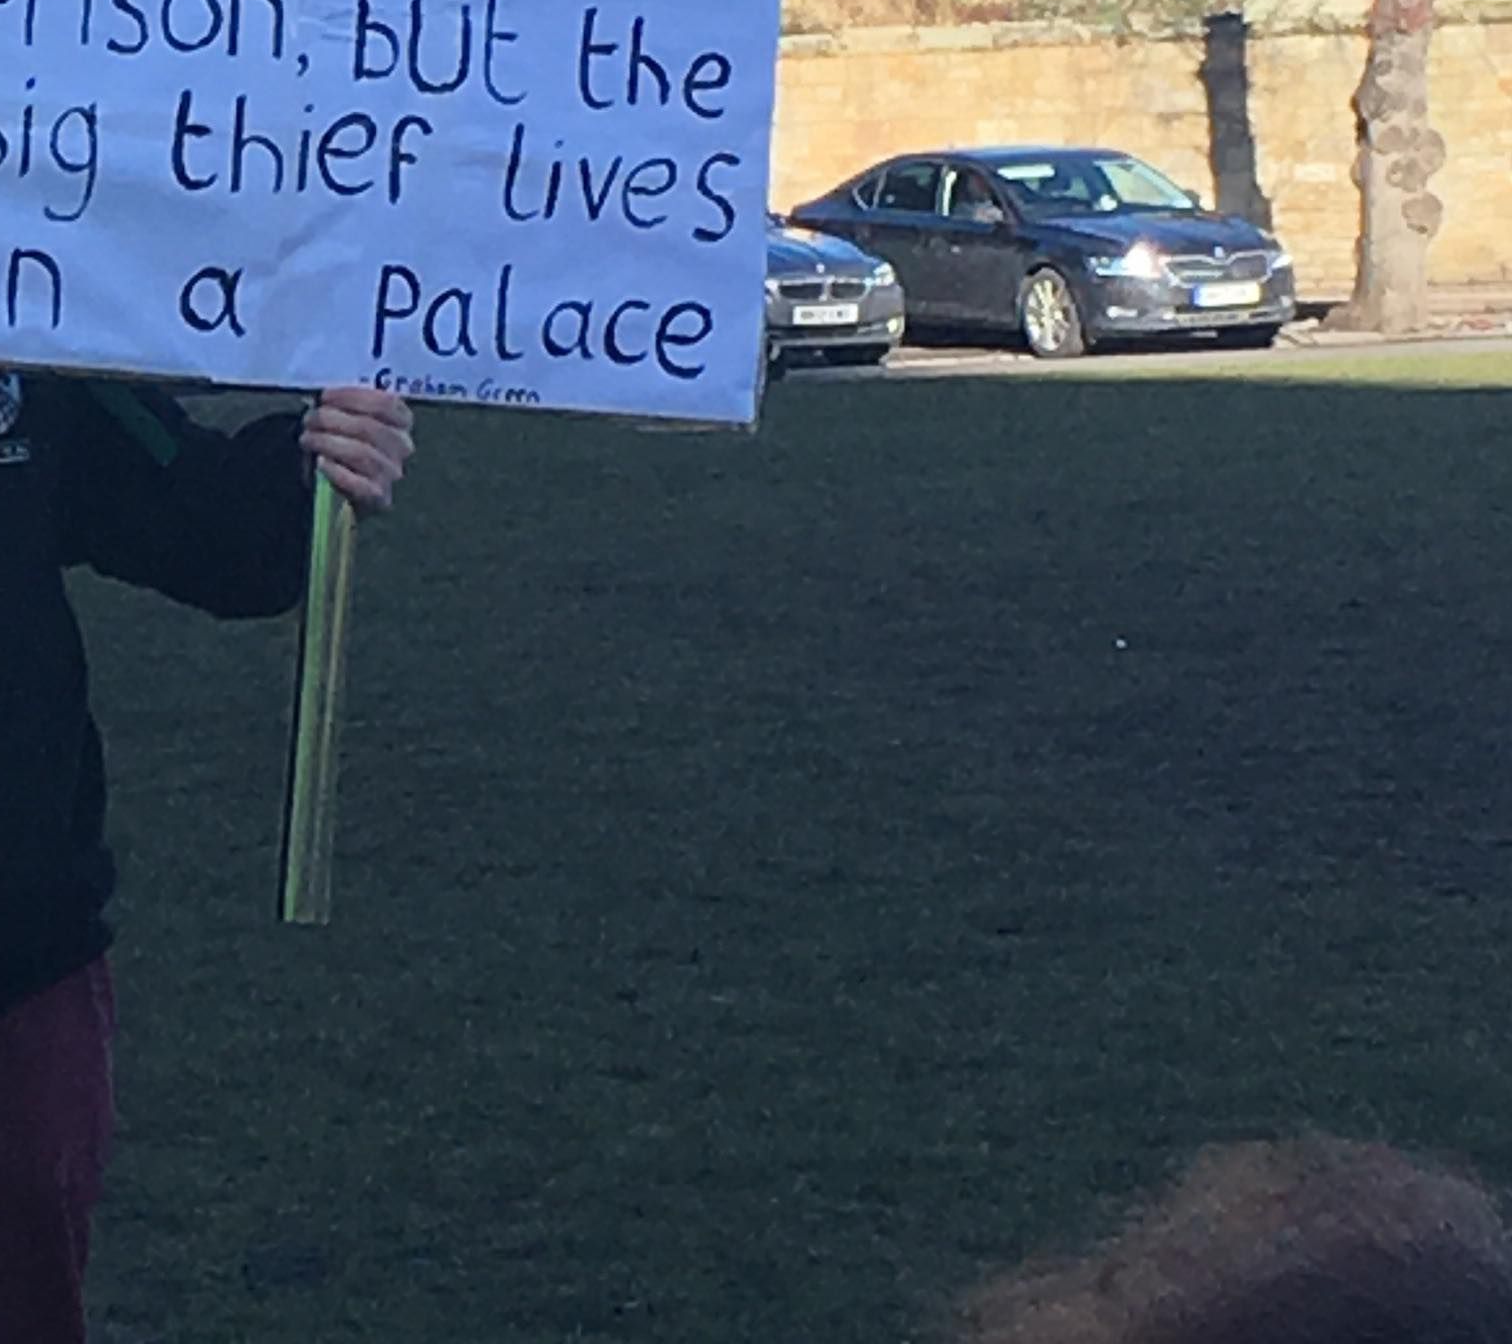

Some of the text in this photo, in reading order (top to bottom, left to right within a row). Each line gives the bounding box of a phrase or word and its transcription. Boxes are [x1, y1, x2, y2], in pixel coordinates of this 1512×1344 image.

[580, 7, 732, 119] the
[172, 89, 432, 203] thief
[503, 123, 741, 242] lives
[179, 267, 245, 337] a
